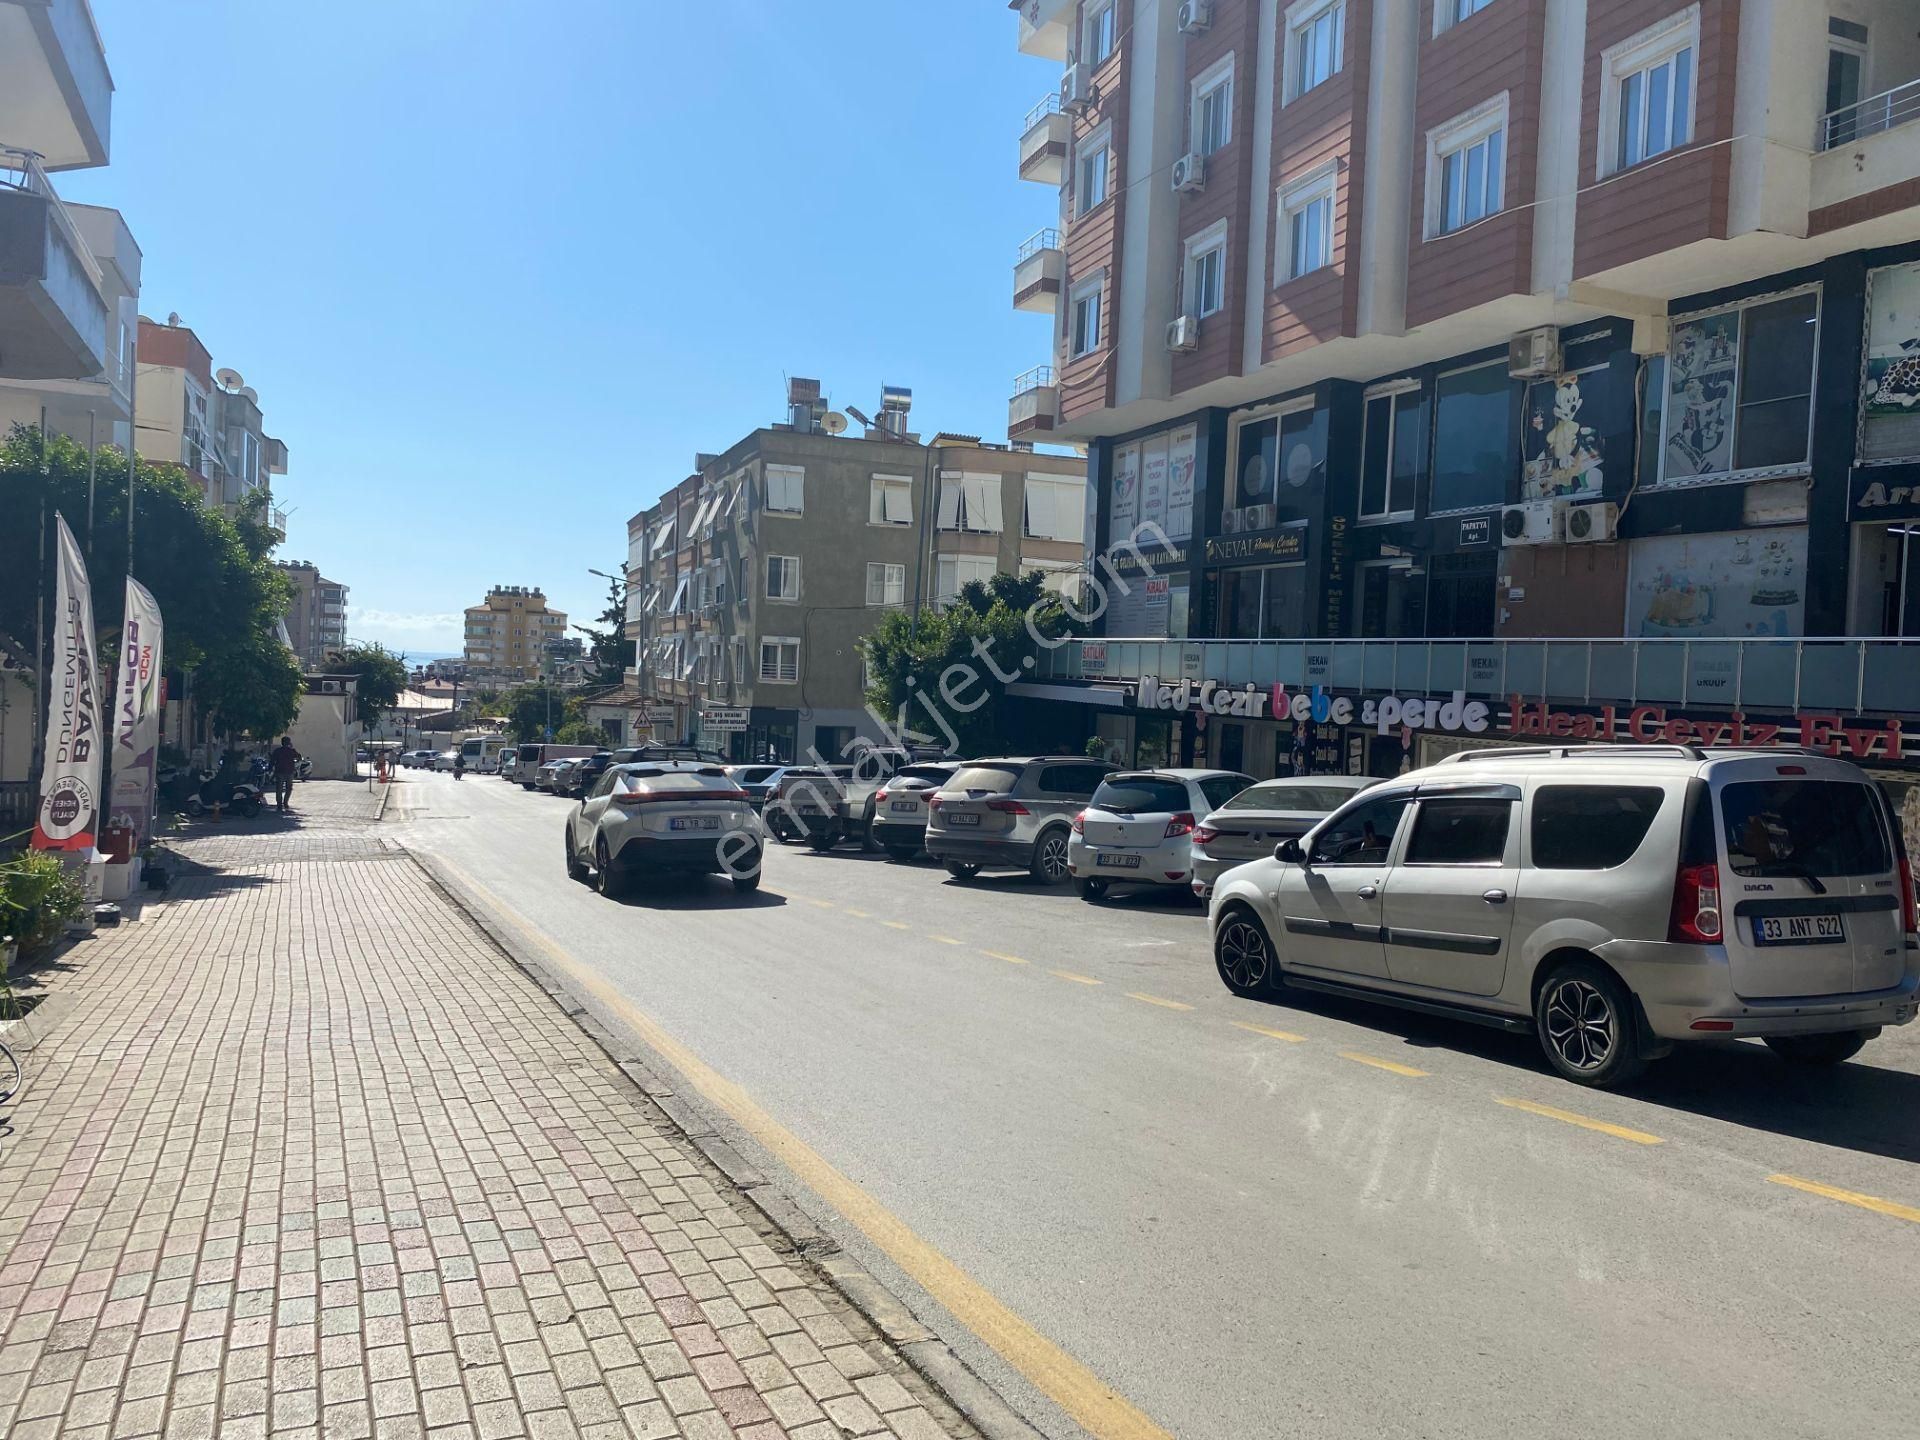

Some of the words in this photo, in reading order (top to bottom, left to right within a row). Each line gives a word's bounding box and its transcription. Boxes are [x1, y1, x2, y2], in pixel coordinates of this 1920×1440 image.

[1462, 521, 1487, 530] PAPATYA
[1215, 539, 1254, 559] NEVAL
[1137, 675, 1267, 718] Med-Cezir
[1272, 682, 1354, 725] bebe
[1361, 699, 1378, 725] &
[1378, 690, 1489, 736] perde
[1796, 714, 1905, 760] Evi
[1764, 919, 1782, 938] 33
[1790, 918, 1812, 936] ANT
[1817, 917, 1840, 935] 622
